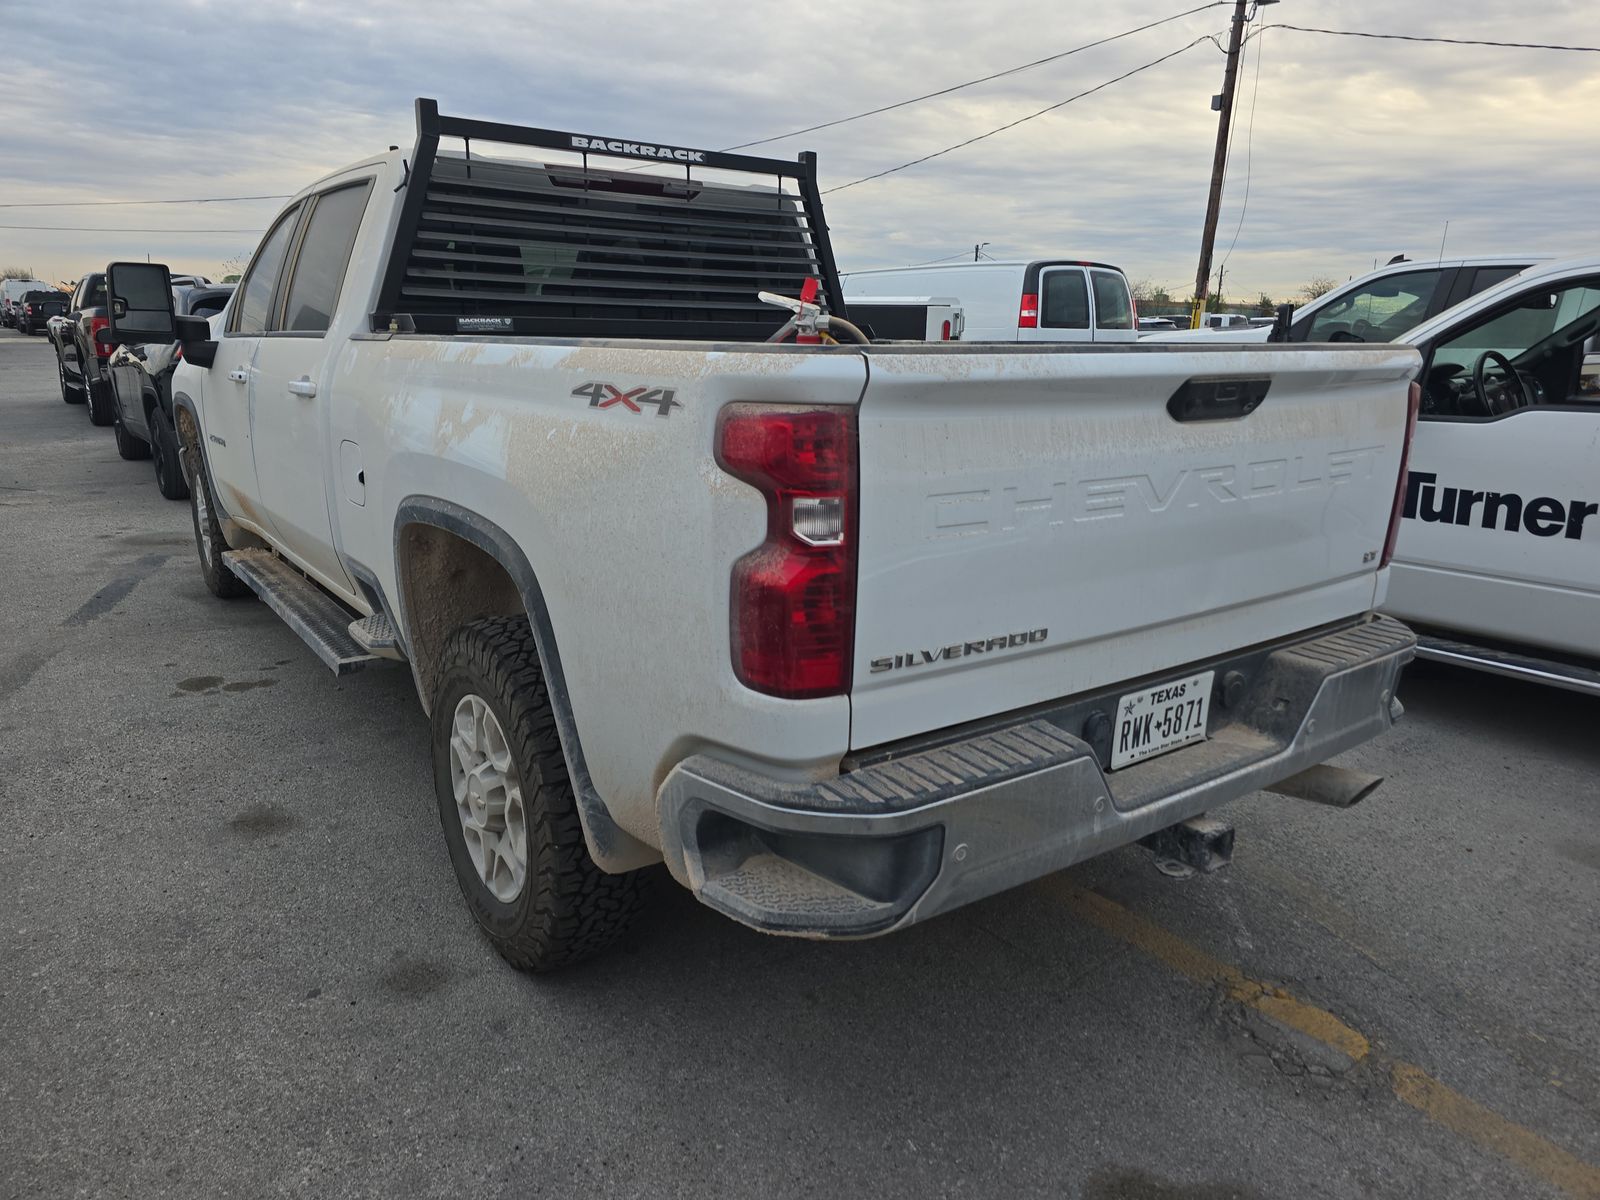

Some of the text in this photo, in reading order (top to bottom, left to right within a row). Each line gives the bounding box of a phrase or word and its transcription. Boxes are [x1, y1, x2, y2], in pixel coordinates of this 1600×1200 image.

[571, 136, 703, 162] BACKRACK
[926, 445, 1386, 538] CHEVROLET
[1401, 470, 1599, 540] Turner
[869, 627, 1048, 674] SILVERADO
[1150, 683, 1187, 706] TEXAS
[1119, 697, 1203, 753] RWK 5871
